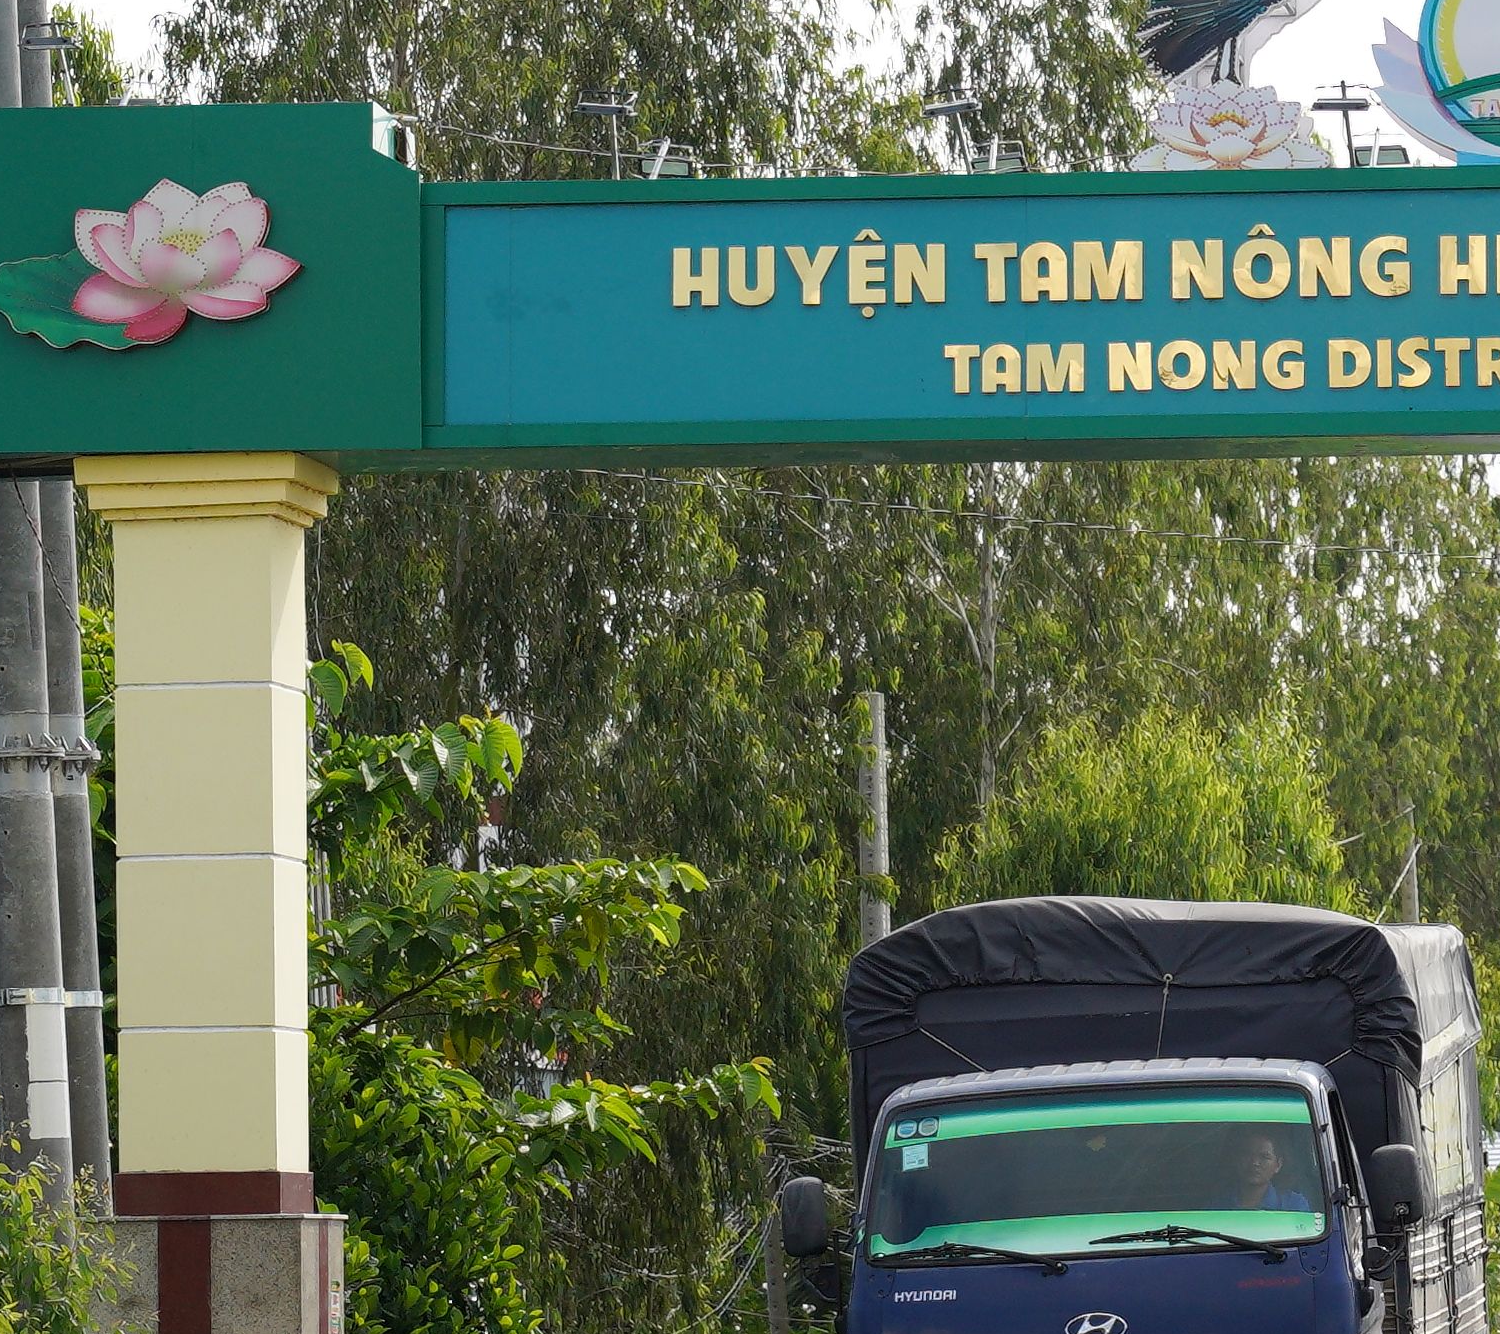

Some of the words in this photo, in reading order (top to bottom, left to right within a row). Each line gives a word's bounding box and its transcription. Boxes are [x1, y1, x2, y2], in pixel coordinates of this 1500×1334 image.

[672, 229, 946, 318] HUYỆN
[974, 239, 1144, 303] TAM
[1171, 224, 1411, 300] NÔNG
[943, 343, 1085, 394] TAM
[1107, 338, 1305, 392] NONG
[894, 1289, 957, 1303] HYUNDAI
